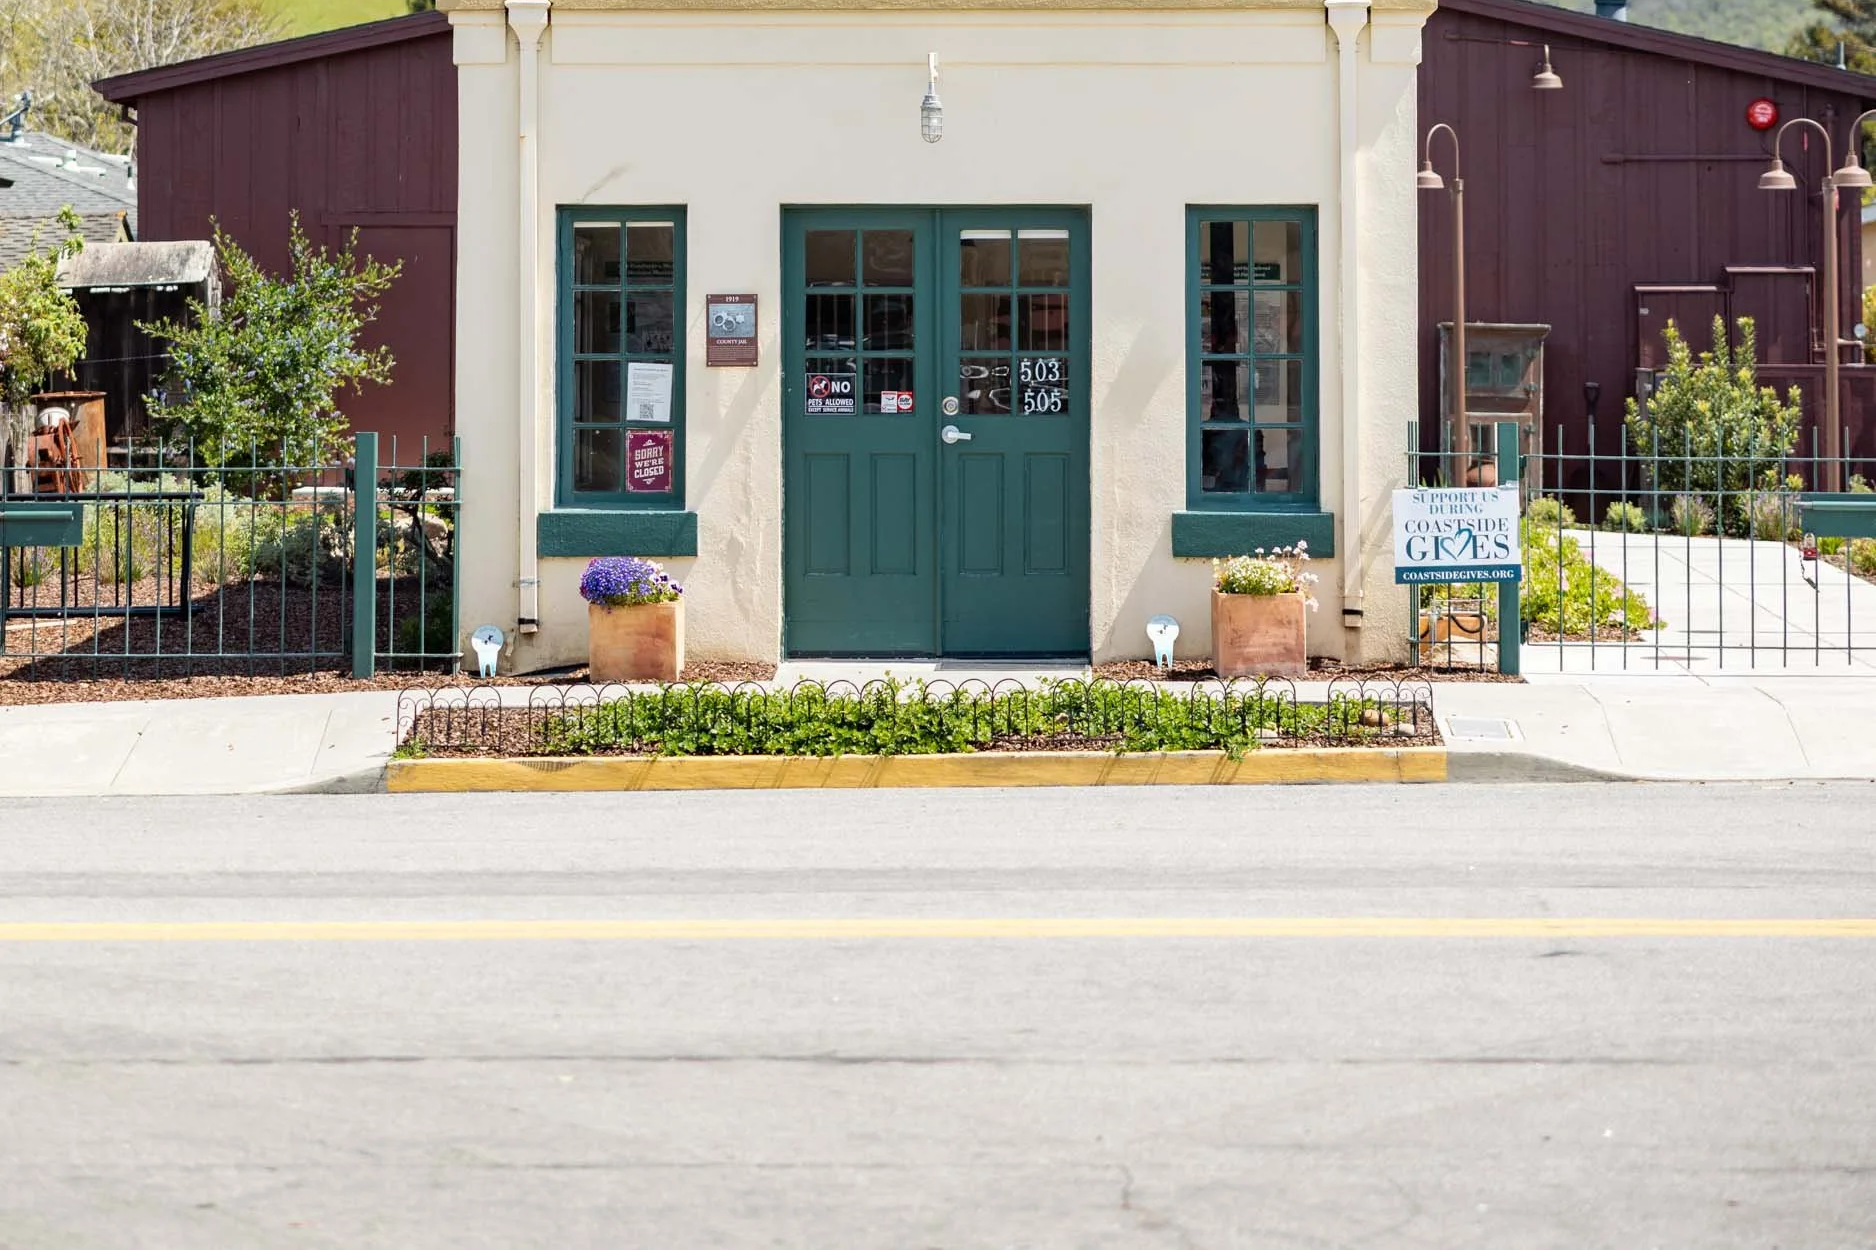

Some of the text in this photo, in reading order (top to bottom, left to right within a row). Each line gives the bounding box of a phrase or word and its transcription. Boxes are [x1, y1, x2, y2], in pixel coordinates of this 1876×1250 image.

[1020, 361, 1060, 382] 503
[831, 381, 851, 393] NO
[808, 398, 854, 406] PETS ALLOWED
[1024, 392, 1062, 412] 505
[634, 446, 664, 460] SORRY
[634, 458, 664, 468] WE'RE
[634, 466, 665, 479] CLOSED
[1412, 491, 1499, 504] SUPPORT US
[1429, 503, 1483, 515] DURING
[1404, 518, 1509, 534] COASTSIDE
[1402, 569, 1514, 581] COASTSIDEGIVES.ORG
